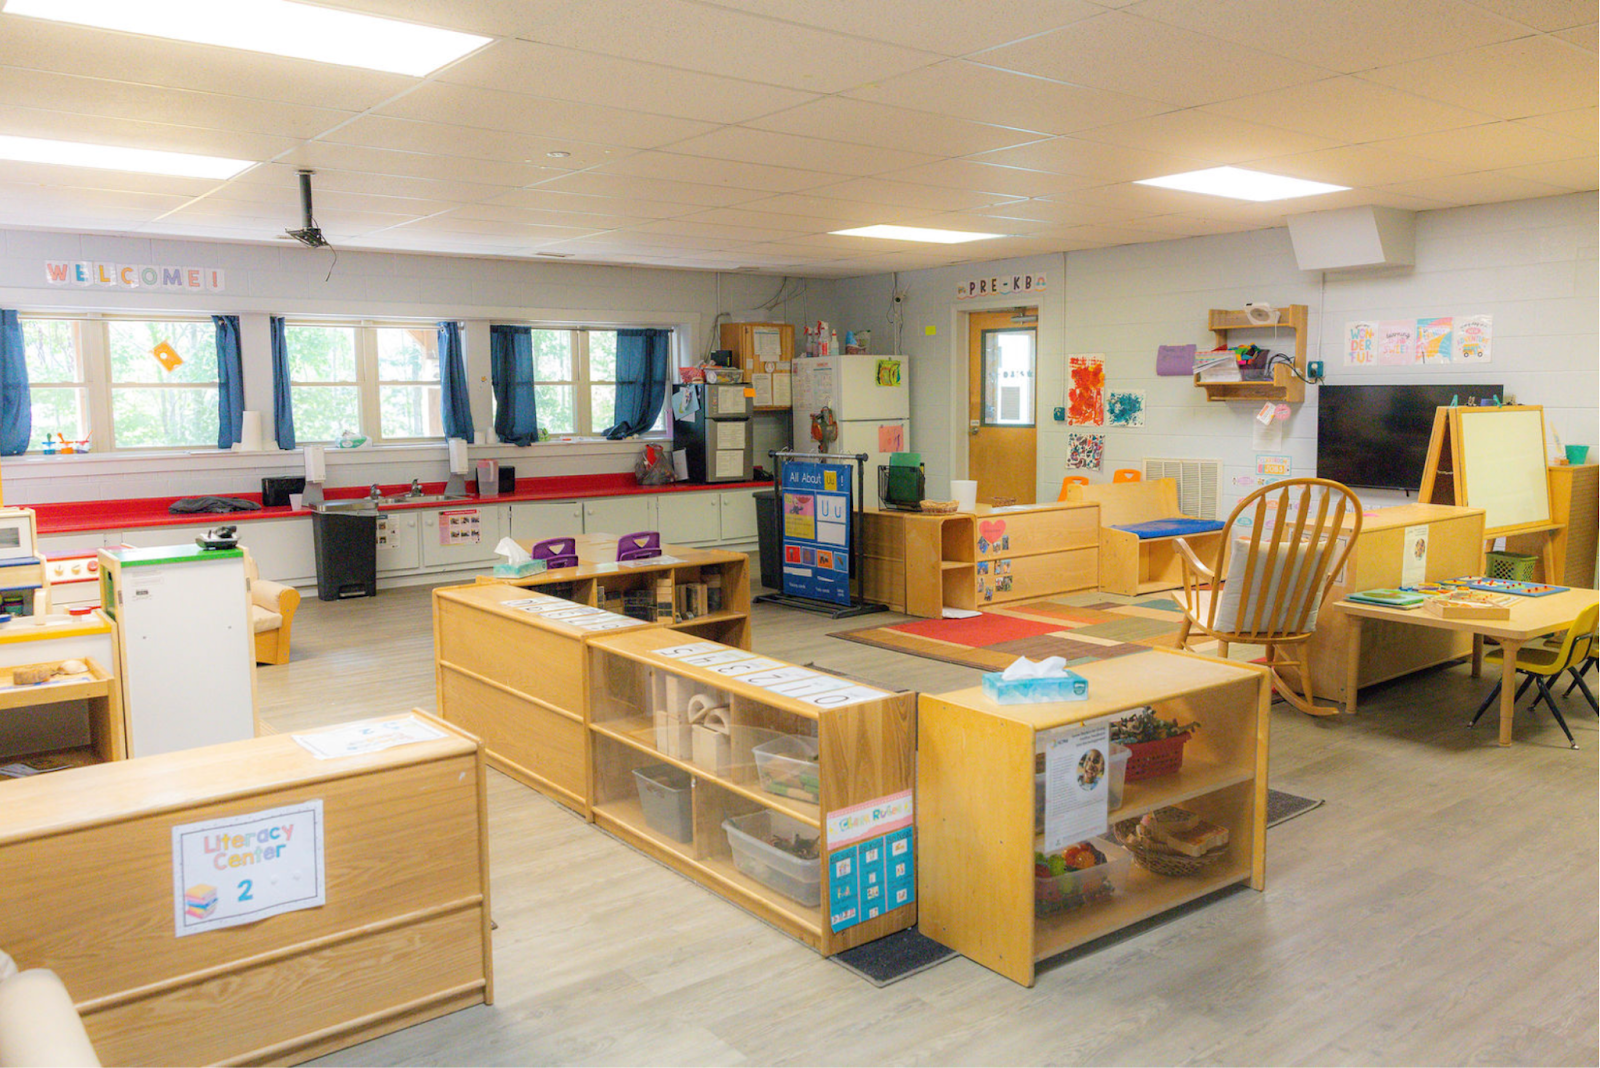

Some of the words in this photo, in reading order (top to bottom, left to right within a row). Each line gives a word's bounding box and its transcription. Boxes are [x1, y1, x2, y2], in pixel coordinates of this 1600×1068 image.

[47, 263, 218, 288] WELCOME!
[969, 275, 1032, 295] PRE-KB
[1350, 339, 1372, 351] DER
[789, 471, 799, 482] All
[801, 473, 822, 484] About
[717, 665, 750, 673] 3
[748, 674, 782, 683] 2
[204, 824, 294, 854] Literacy
[213, 844, 286, 871] Center
[237, 879, 253, 902] 2
